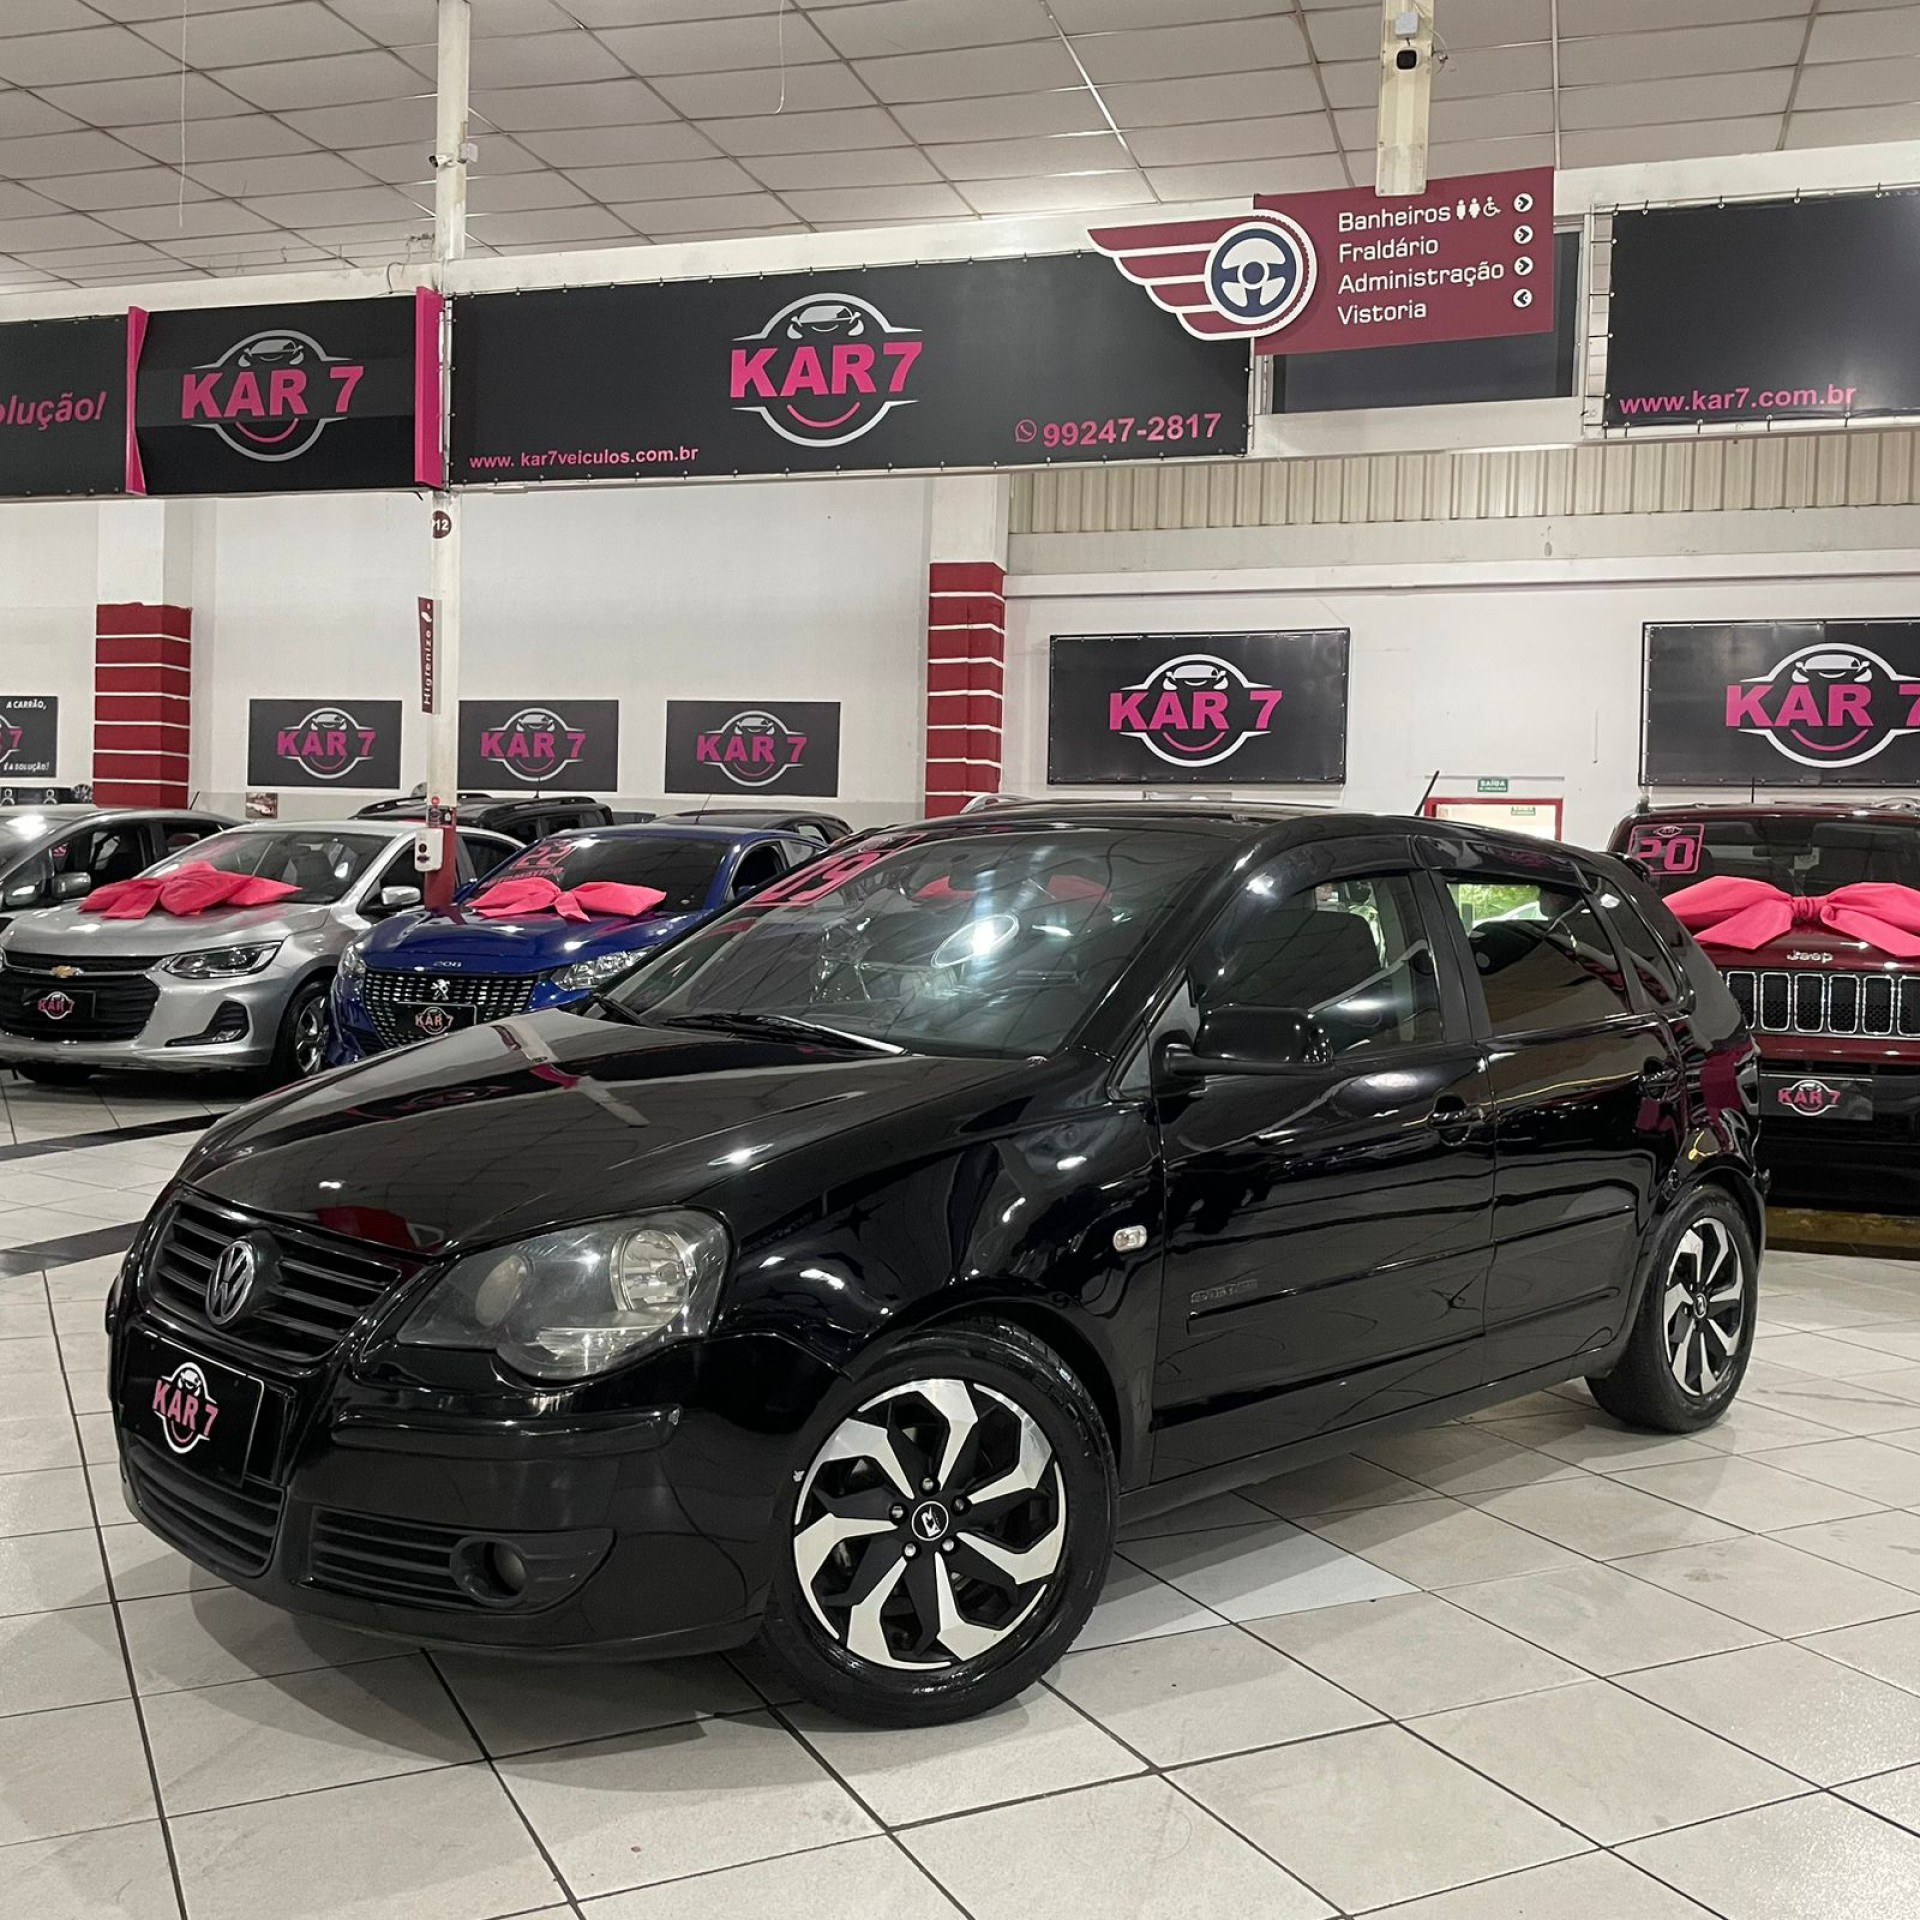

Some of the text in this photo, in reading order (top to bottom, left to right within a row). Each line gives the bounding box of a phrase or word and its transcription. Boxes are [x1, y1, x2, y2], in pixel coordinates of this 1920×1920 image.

[1338, 205, 1451, 232] Banheiros
[1339, 235, 1439, 263] Fraldário
[1338, 261, 1505, 295] Administração
[1337, 300, 1427, 325] Vistoria
[181, 365, 364, 419] KAR 7
[1620, 384, 1856, 414] www.kar7.com.br
[1043, 413, 1222, 447] 99247-2817
[521, 446, 699, 467] kar7veiculos.com.br
[423, 629, 432, 705] Higienize
[1109, 690, 1283, 730] KAR 7
[1726, 684, 1874, 727] KAR
[276, 731, 376, 756] KAR 7
[481, 732, 586, 758] KAR 7
[696, 735, 807, 763] KAR 7
[1787, 950, 1834, 964] Jeep
[37, 998, 65, 1011] KAR
[415, 1013, 443, 1026] KAR
[1777, 1088, 1841, 1104] KAR 7
[152, 1379, 219, 1437] KAR 7
